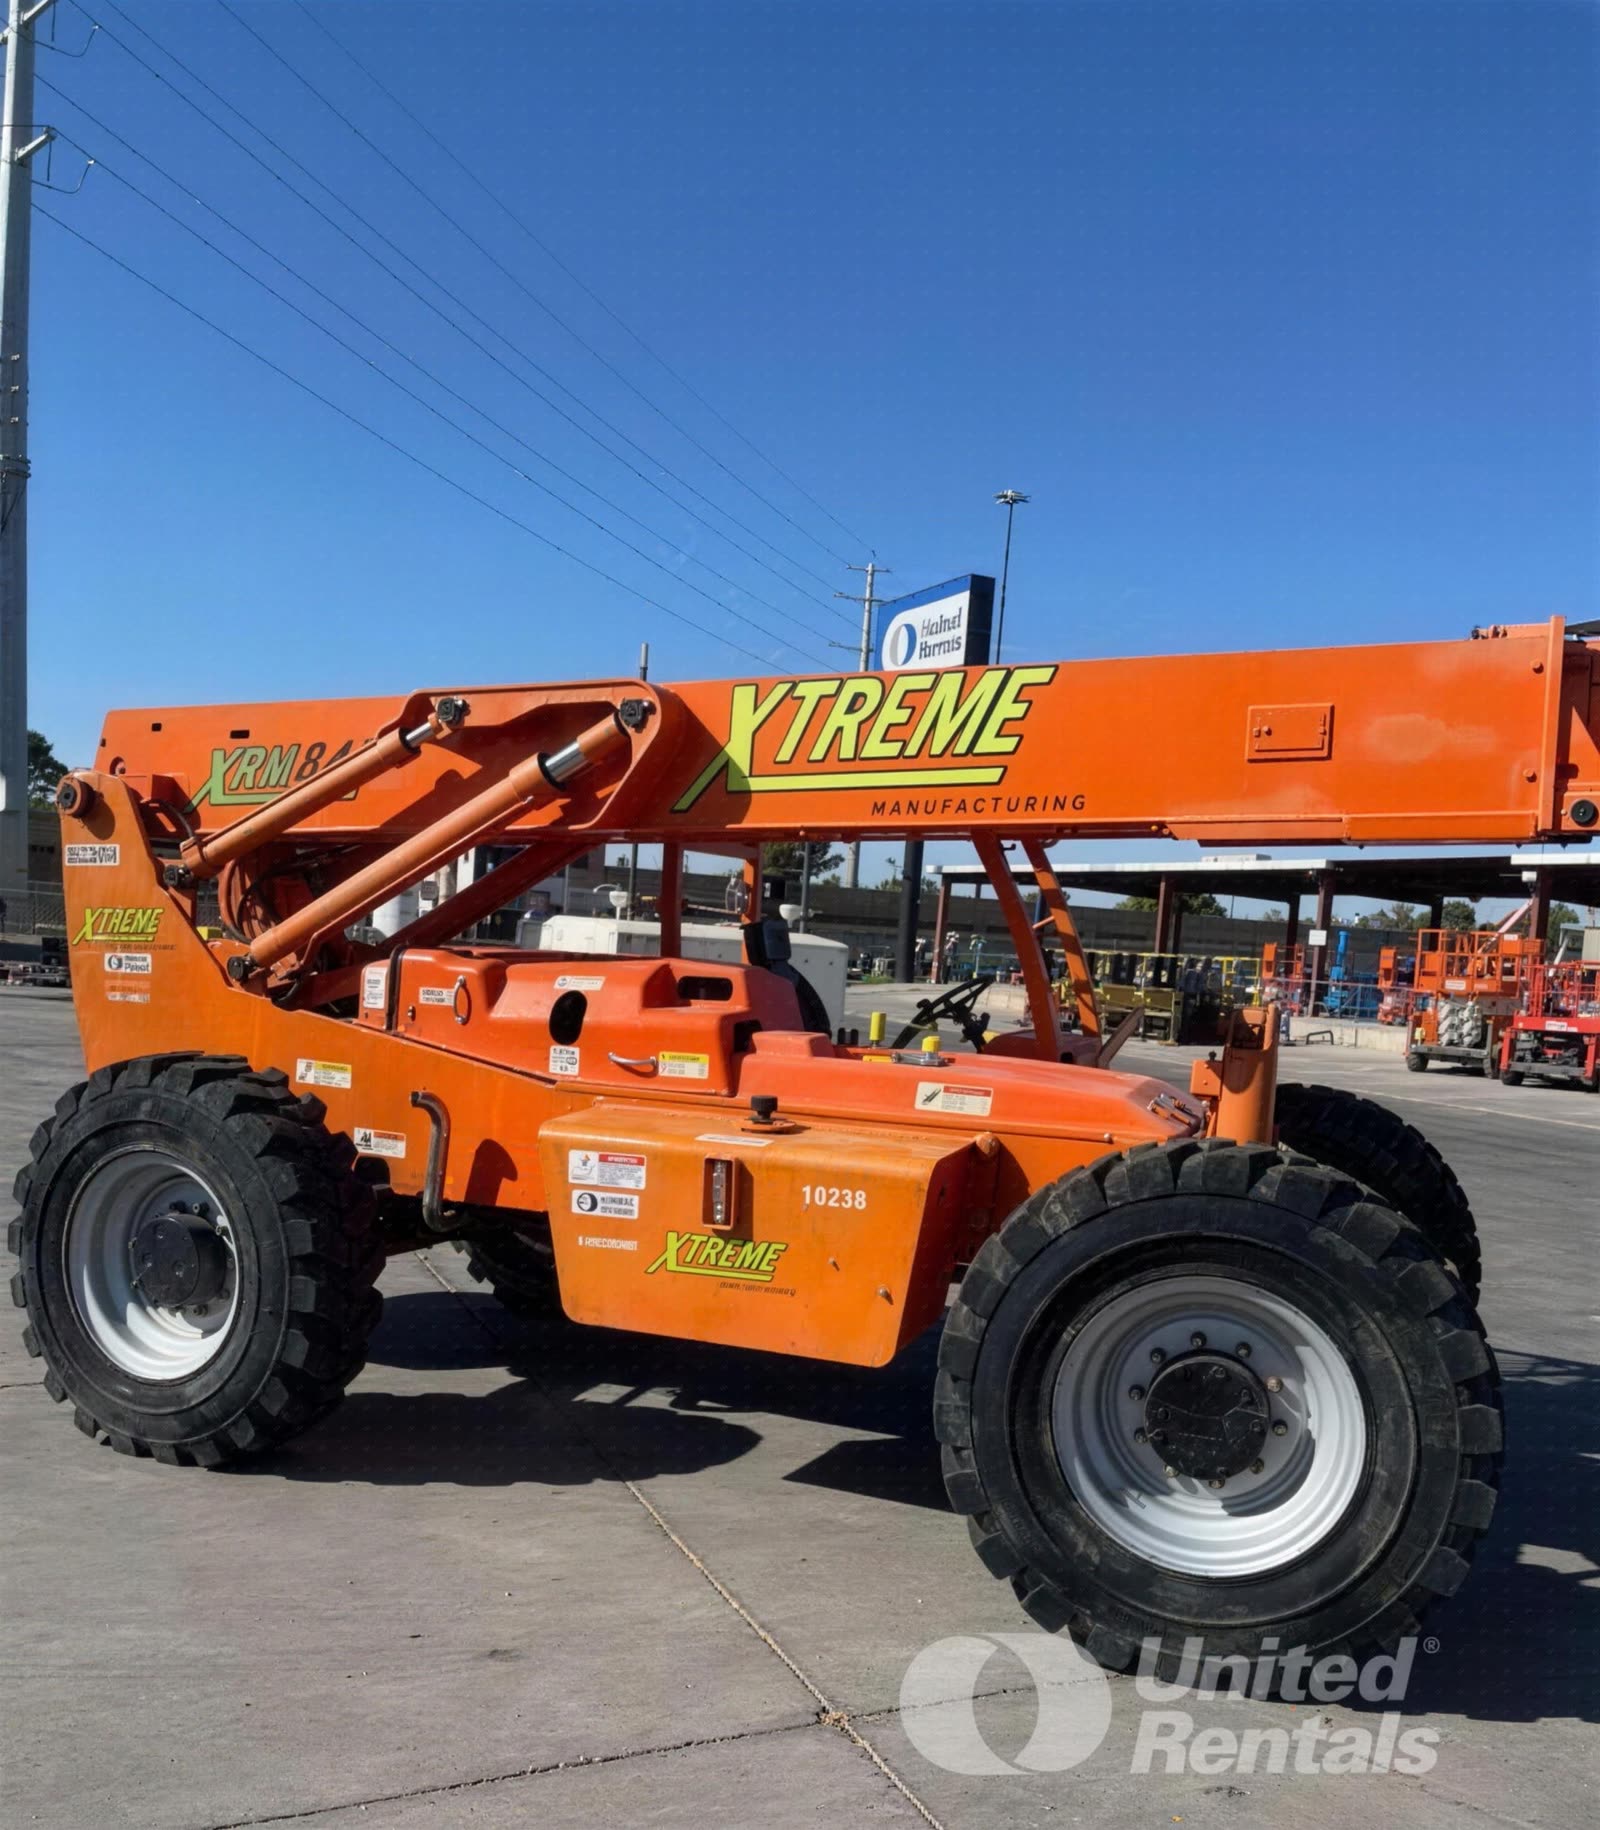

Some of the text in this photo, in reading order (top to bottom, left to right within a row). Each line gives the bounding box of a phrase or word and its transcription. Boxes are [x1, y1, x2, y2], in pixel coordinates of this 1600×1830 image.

[670, 664, 1060, 814] XTREME
[871, 794, 1087, 817] MANUFACTURING
[801, 1184, 867, 1210] 10238
[644, 1230, 789, 1282] XTREME
